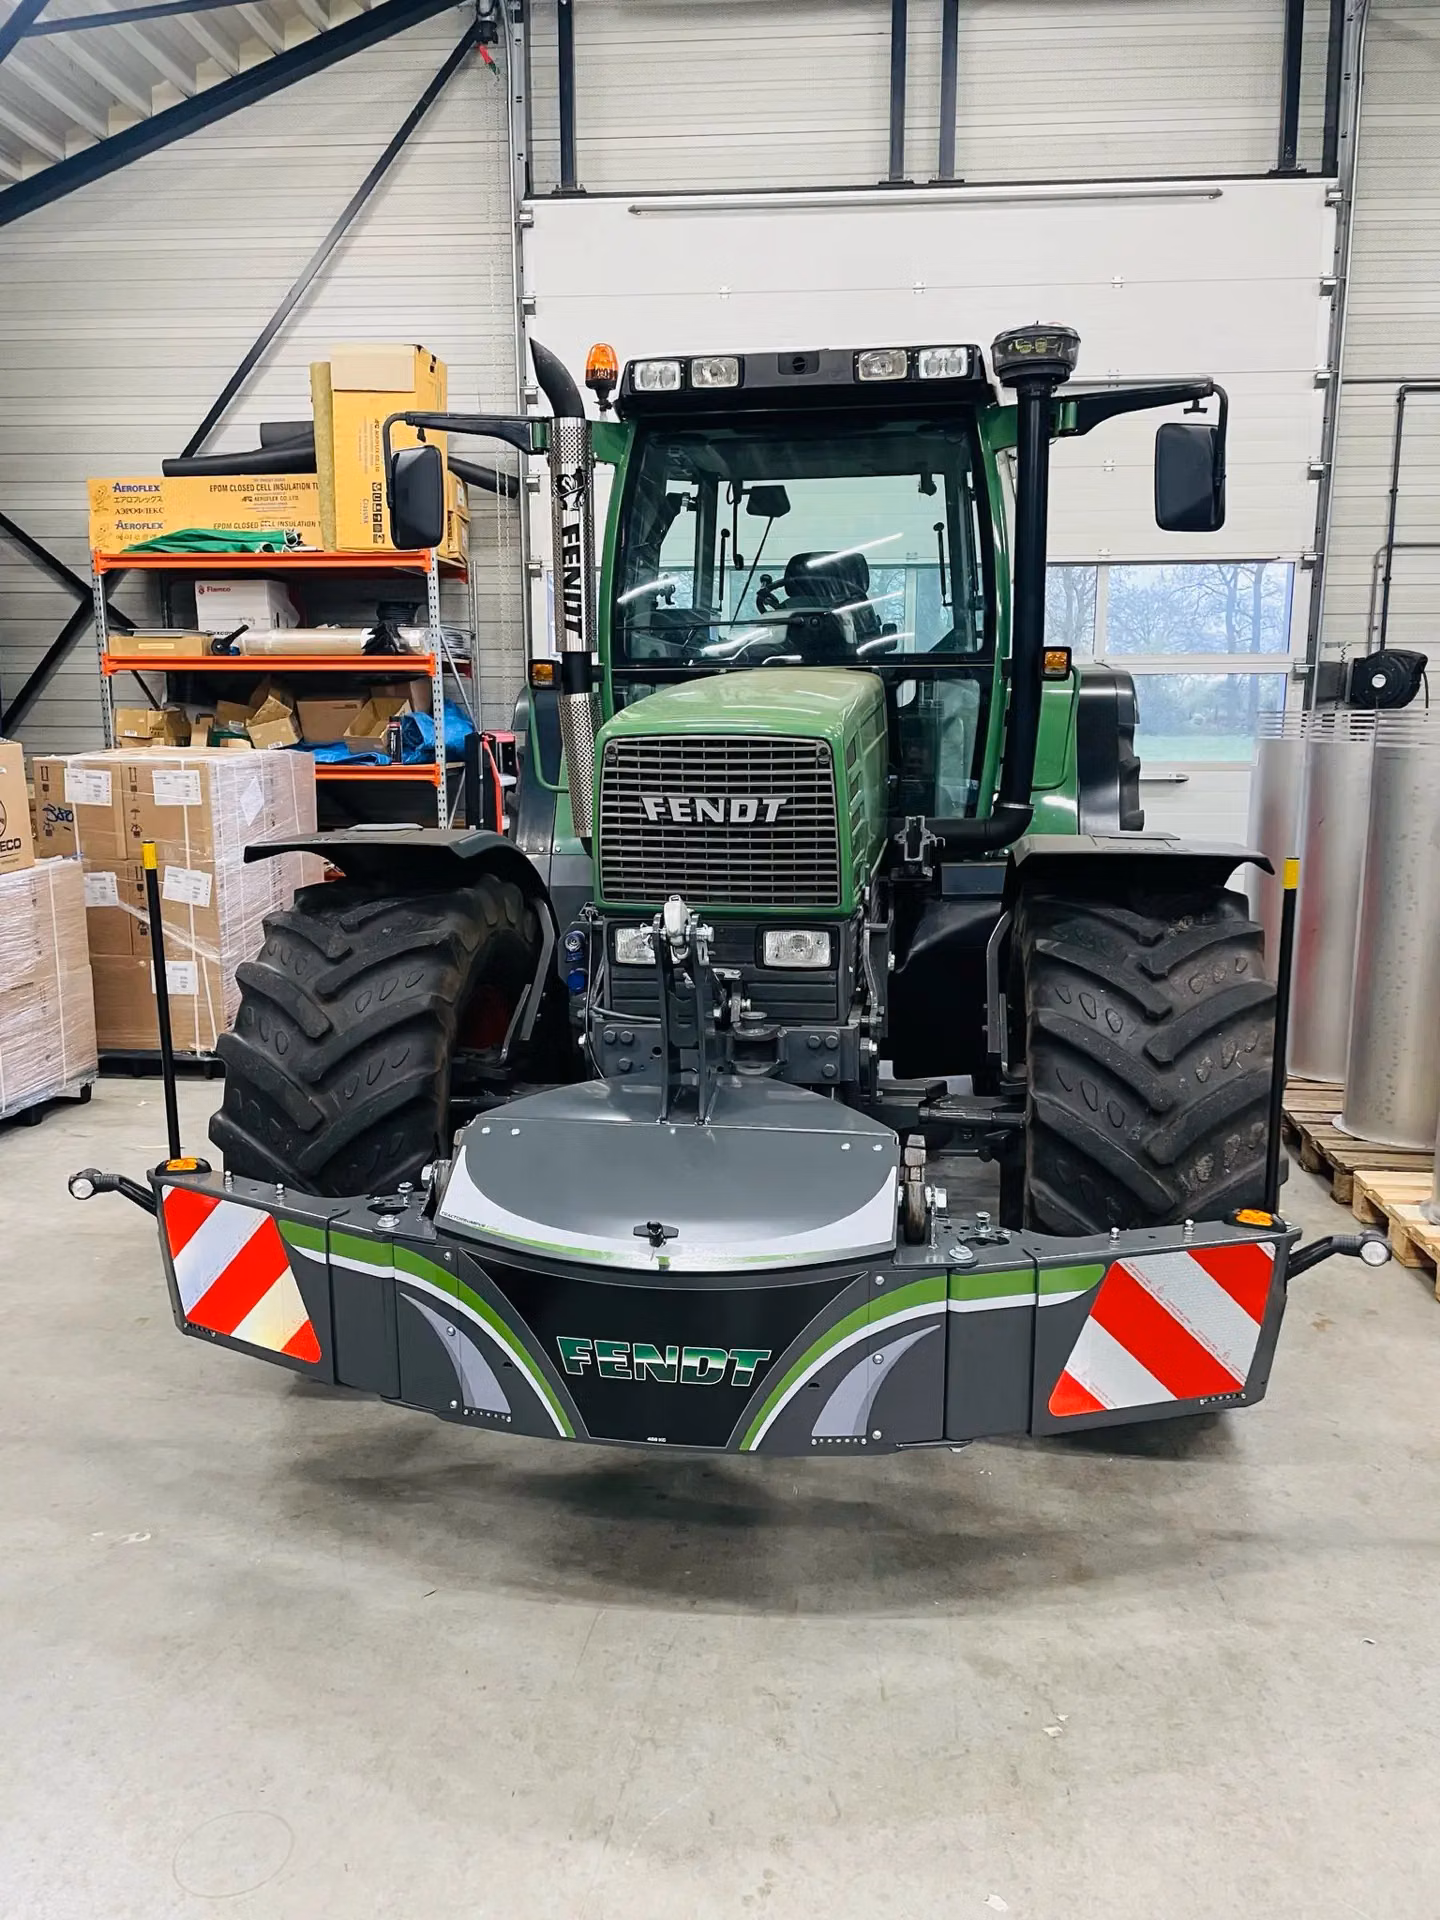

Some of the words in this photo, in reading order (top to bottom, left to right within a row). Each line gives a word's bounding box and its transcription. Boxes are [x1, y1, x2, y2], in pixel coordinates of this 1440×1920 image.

[112, 482, 161, 493] AEROFLEX
[209, 484, 228, 493] EPDM
[229, 483, 255, 492] CLOSED
[256, 483, 272, 491] CELL
[273, 482, 311, 491] INSULATION
[115, 519, 164, 530] AEROFLEX
[213, 522, 232, 530] EPDM
[233, 521, 259, 529] CLOSED
[278, 520, 316, 528] INSULATION
[562, 522, 583, 640] FENDT
[206, 585, 231, 593] Flamco
[640, 796, 788, 823] FENDT
[556, 1336, 772, 1387] FENDT
